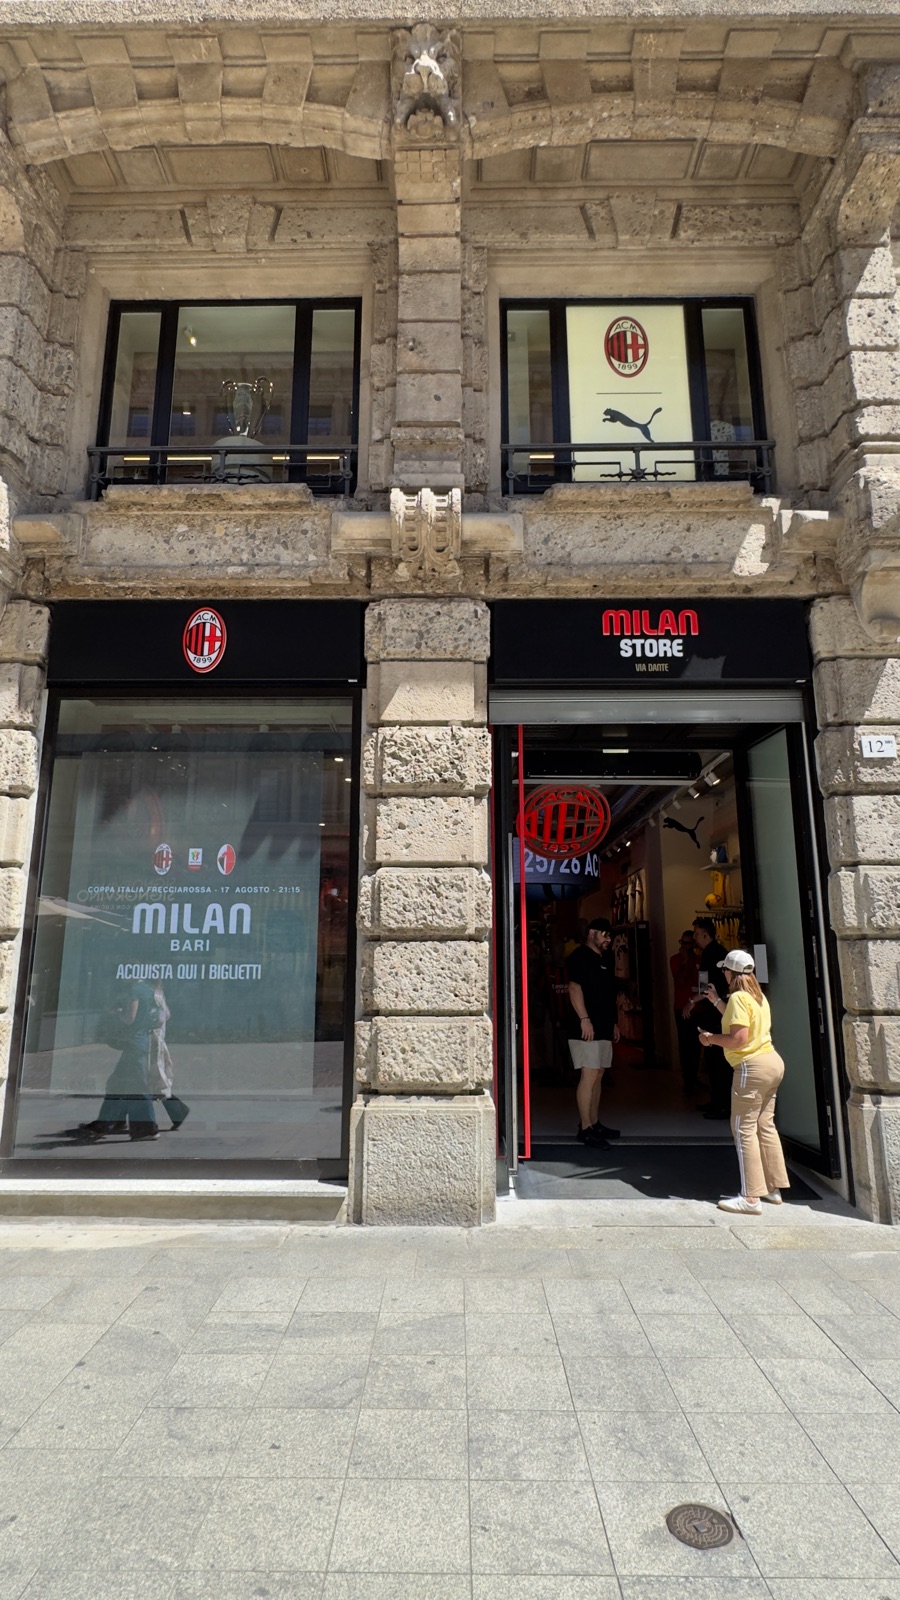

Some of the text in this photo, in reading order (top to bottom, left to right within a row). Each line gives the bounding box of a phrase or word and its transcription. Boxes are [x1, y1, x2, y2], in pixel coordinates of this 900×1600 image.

[614, 321, 637, 332] ACM
[194, 613, 217, 623] ACM
[602, 609, 699, 635] MILAN
[620, 639, 684, 657] STORE
[635, 663, 669, 672] VIA DANTE
[868, 740, 884, 752] 12
[541, 791, 591, 804] ACM
[541, 843, 581, 853] 1899
[147, 886, 212, 894] FRECCIAROSSA
[132, 903, 251, 934] MILAN
[170, 939, 210, 951] BARI
[116, 964, 262, 980] ACQUISTA QUI I BIGLIETTI
